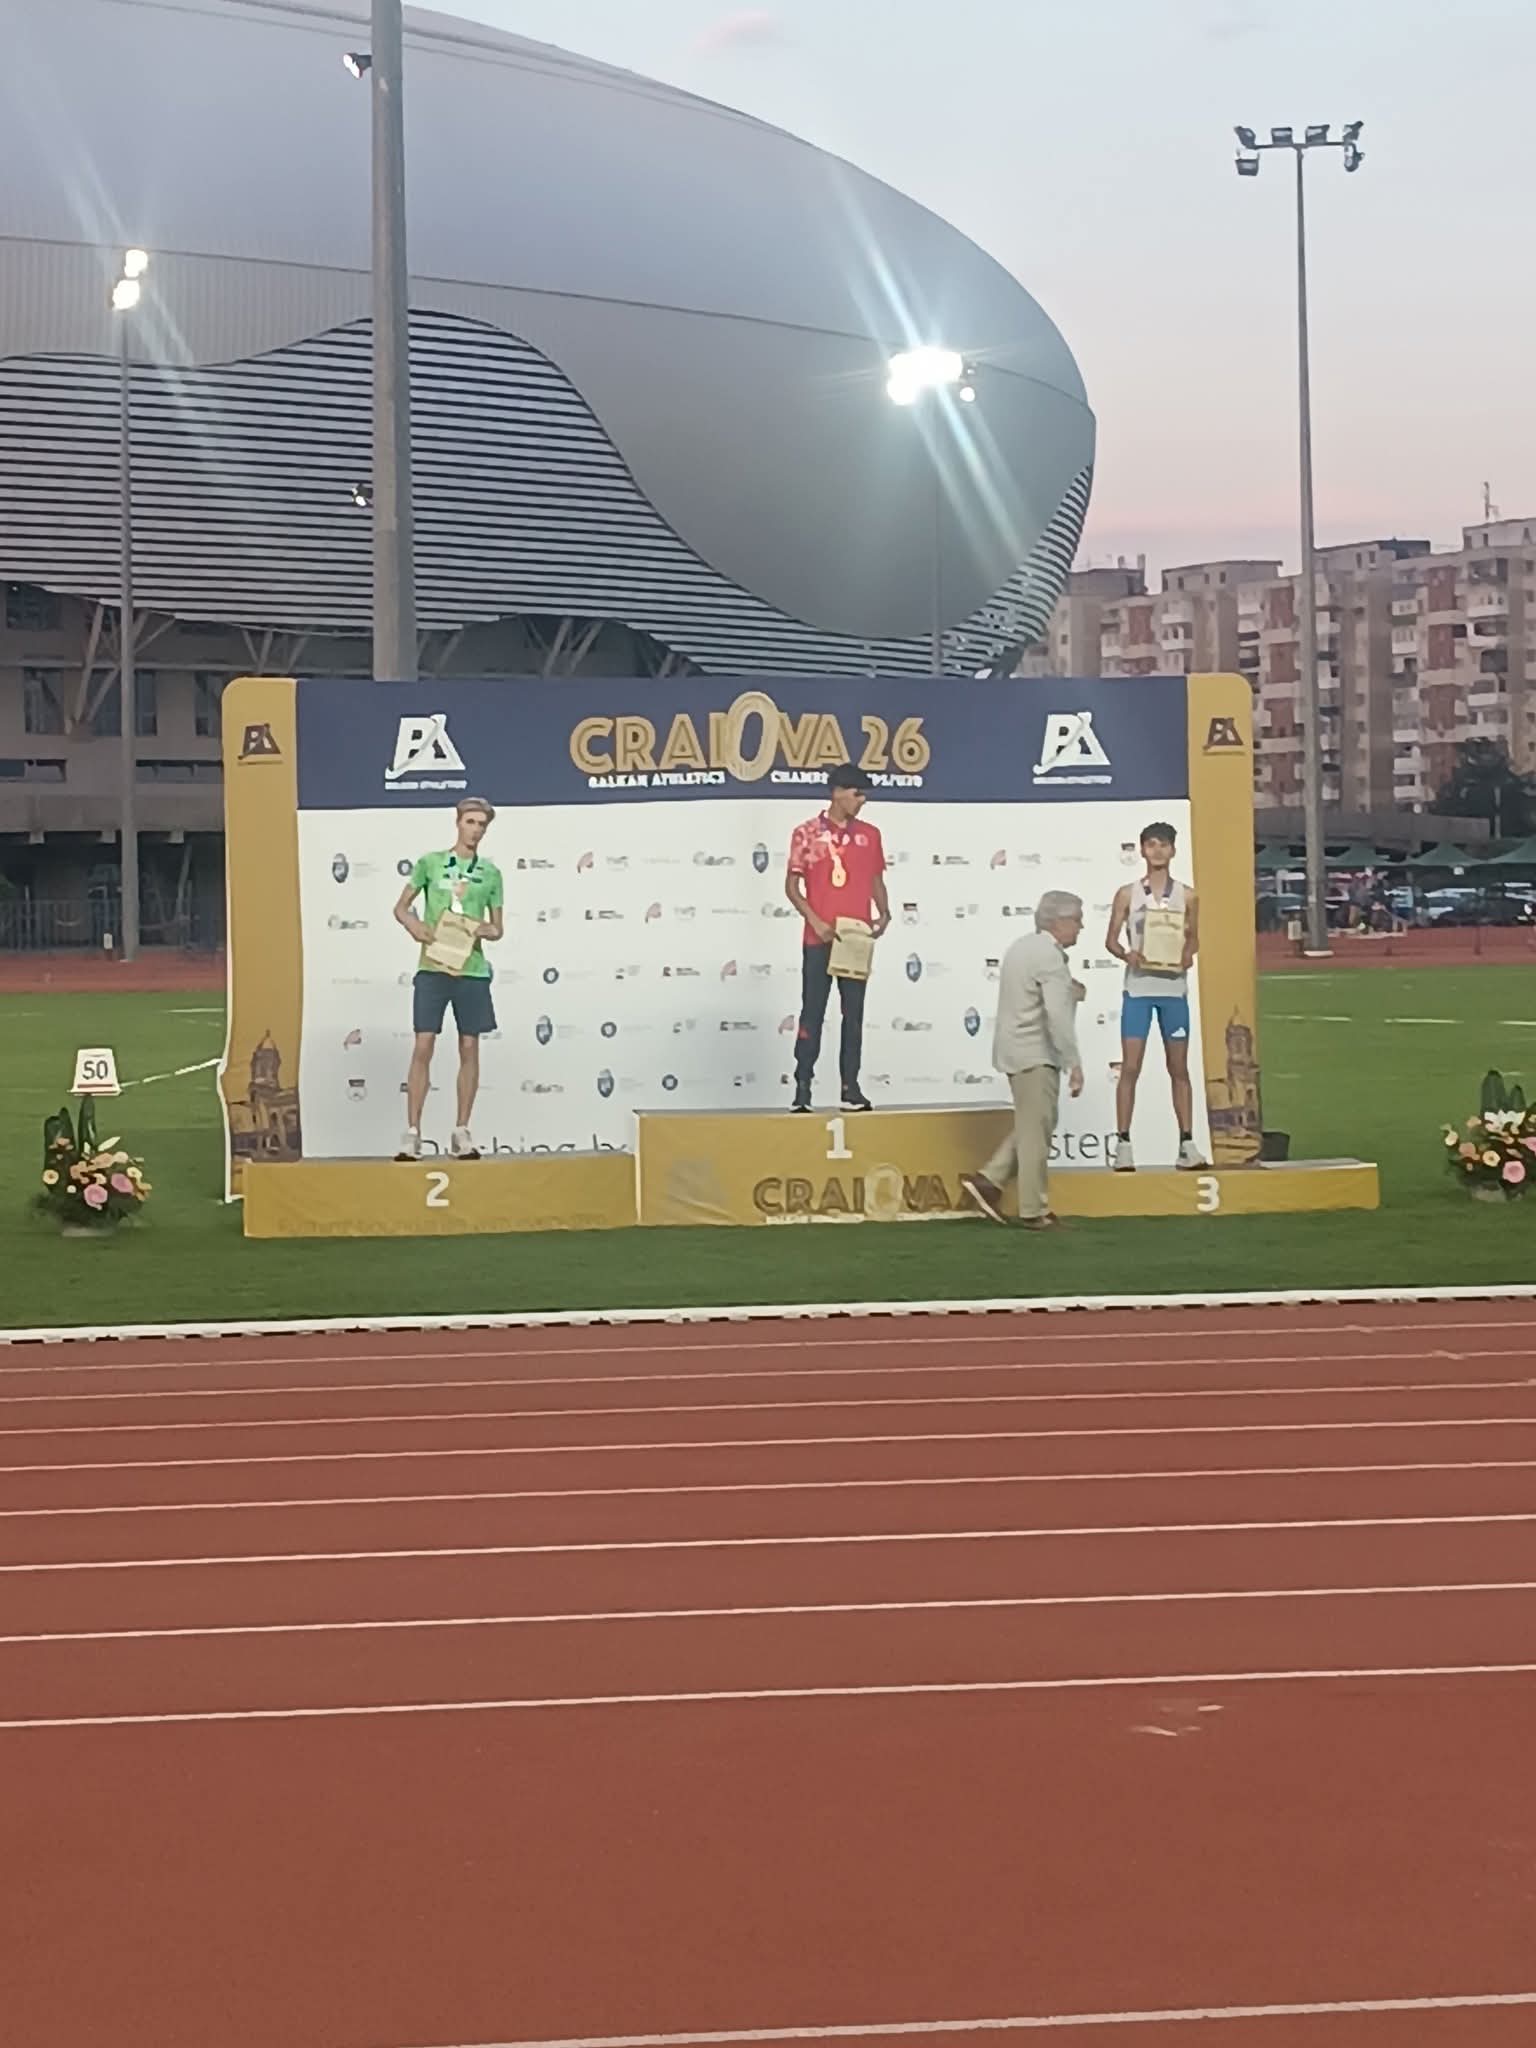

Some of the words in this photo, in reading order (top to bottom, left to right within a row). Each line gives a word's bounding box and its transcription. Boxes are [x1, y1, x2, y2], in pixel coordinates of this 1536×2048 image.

[569, 691, 851, 782] CRAIOVA
[857, 714, 931, 772] 26
[82, 1060, 109, 1081] 50
[826, 1118, 853, 1159] 1
[425, 1171, 450, 1207] 2
[753, 1162, 951, 1221] CRAIOVA
[1197, 1176, 1221, 1212] 3
